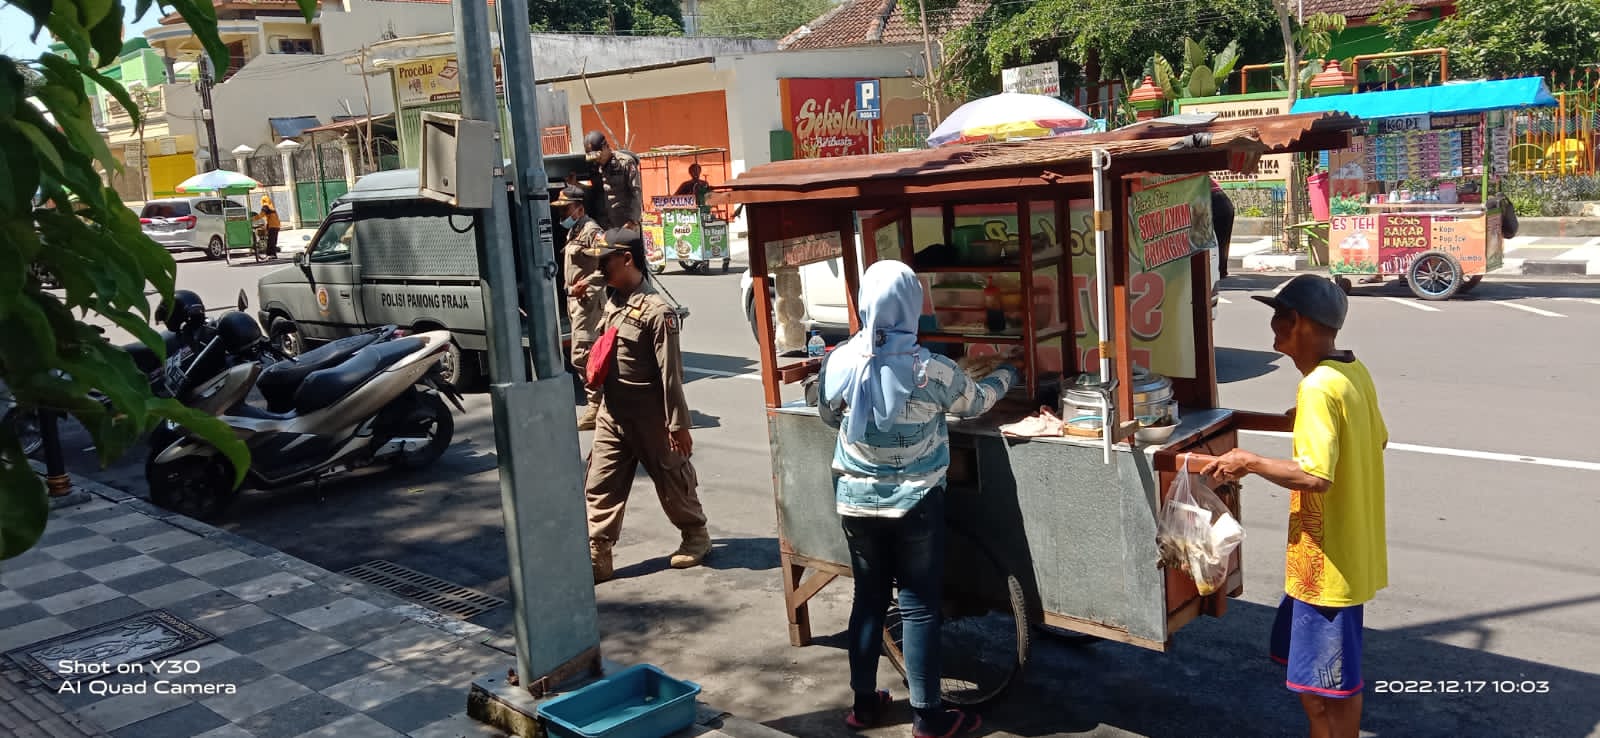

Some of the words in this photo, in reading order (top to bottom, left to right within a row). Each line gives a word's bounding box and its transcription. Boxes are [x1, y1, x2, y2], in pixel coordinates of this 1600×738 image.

[399, 64, 433, 78] Procella
[861, 82, 874, 108] P
[1238, 109, 1264, 117] KARTIKA
[1387, 117, 1421, 130] KOPI
[1259, 159, 1280, 169] TIKA
[1138, 209, 1162, 241] SOTO
[1163, 203, 1191, 233] AYAM
[1332, 217, 1346, 231] ES
[1352, 216, 1375, 230] TEH
[1388, 216, 1421, 225] SOSIS
[1384, 225, 1424, 237] BAKAR
[1383, 237, 1428, 248] JUMBO
[381, 292, 406, 307] POLISI
[406, 293, 440, 309] PAMONG
[442, 294, 470, 310] PRAJA
